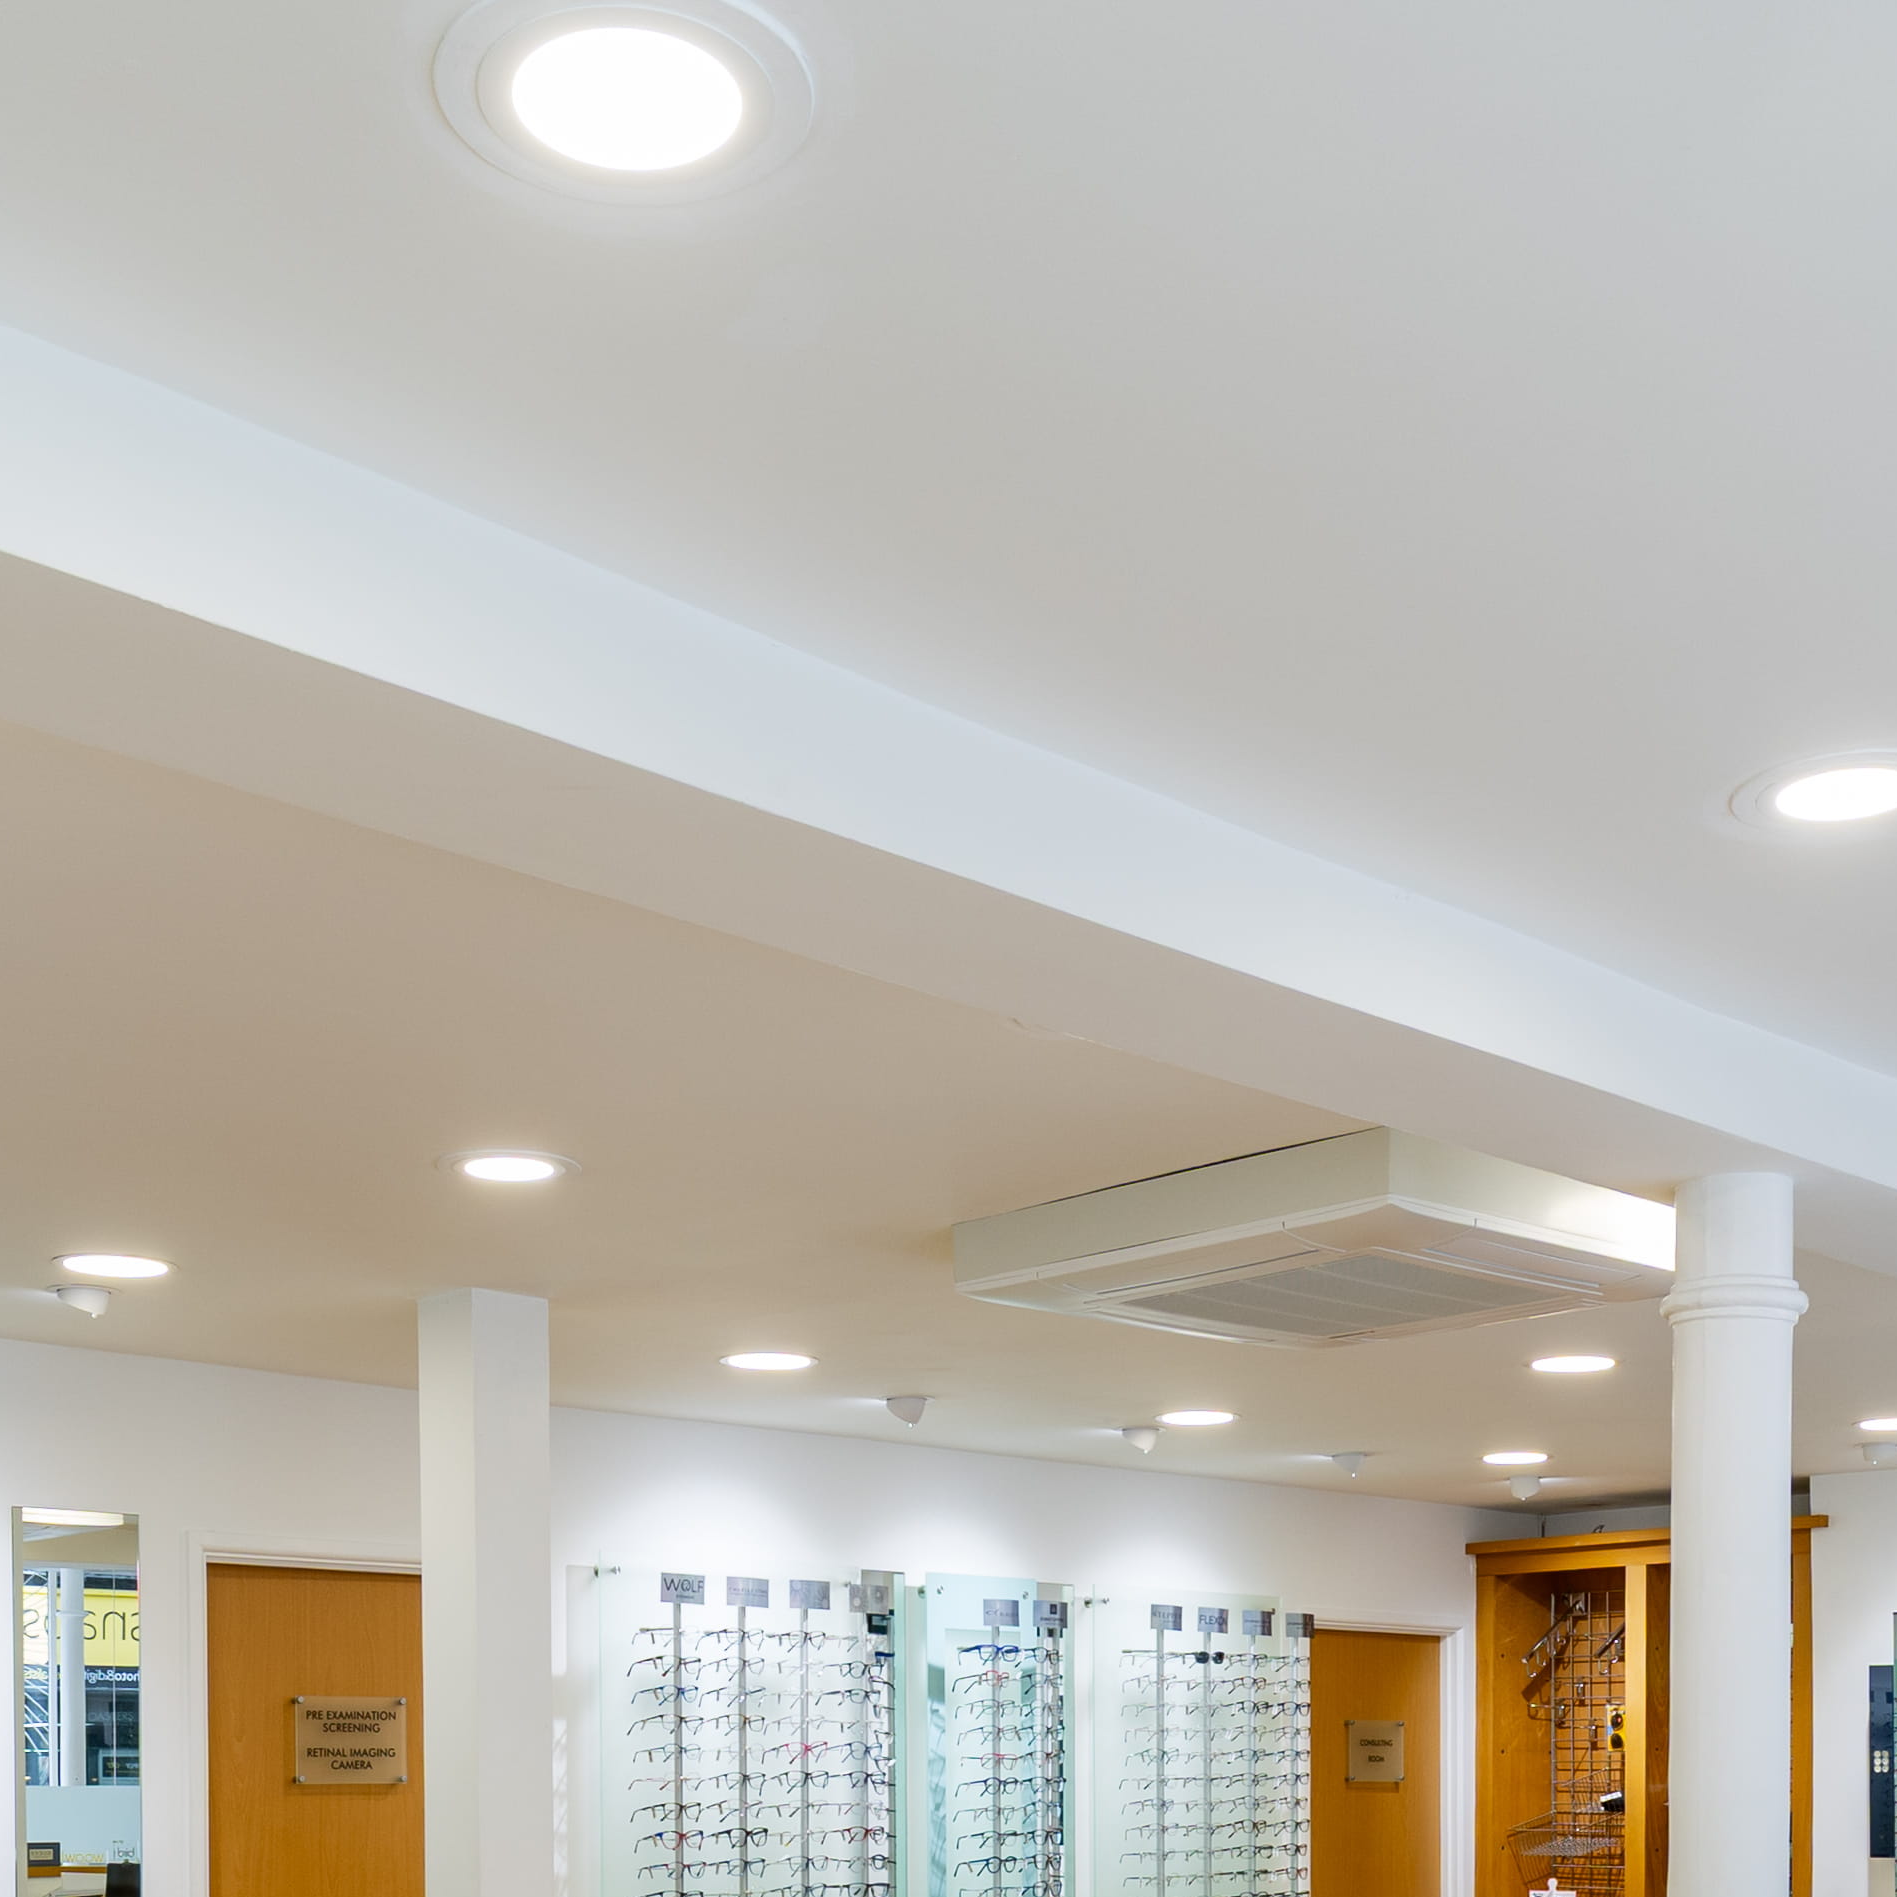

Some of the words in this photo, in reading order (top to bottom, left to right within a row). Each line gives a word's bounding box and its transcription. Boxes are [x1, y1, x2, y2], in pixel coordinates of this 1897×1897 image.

[663, 1577, 704, 1594] WOLF
[306, 1710, 323, 1720] PRE
[326, 1710, 397, 1721] EXAMINATION
[322, 1722, 381, 1733] SCREENING
[306, 1747, 347, 1758] RETINAL
[349, 1747, 396, 1758] IMAGING
[330, 1760, 373, 1770] CAMERA
